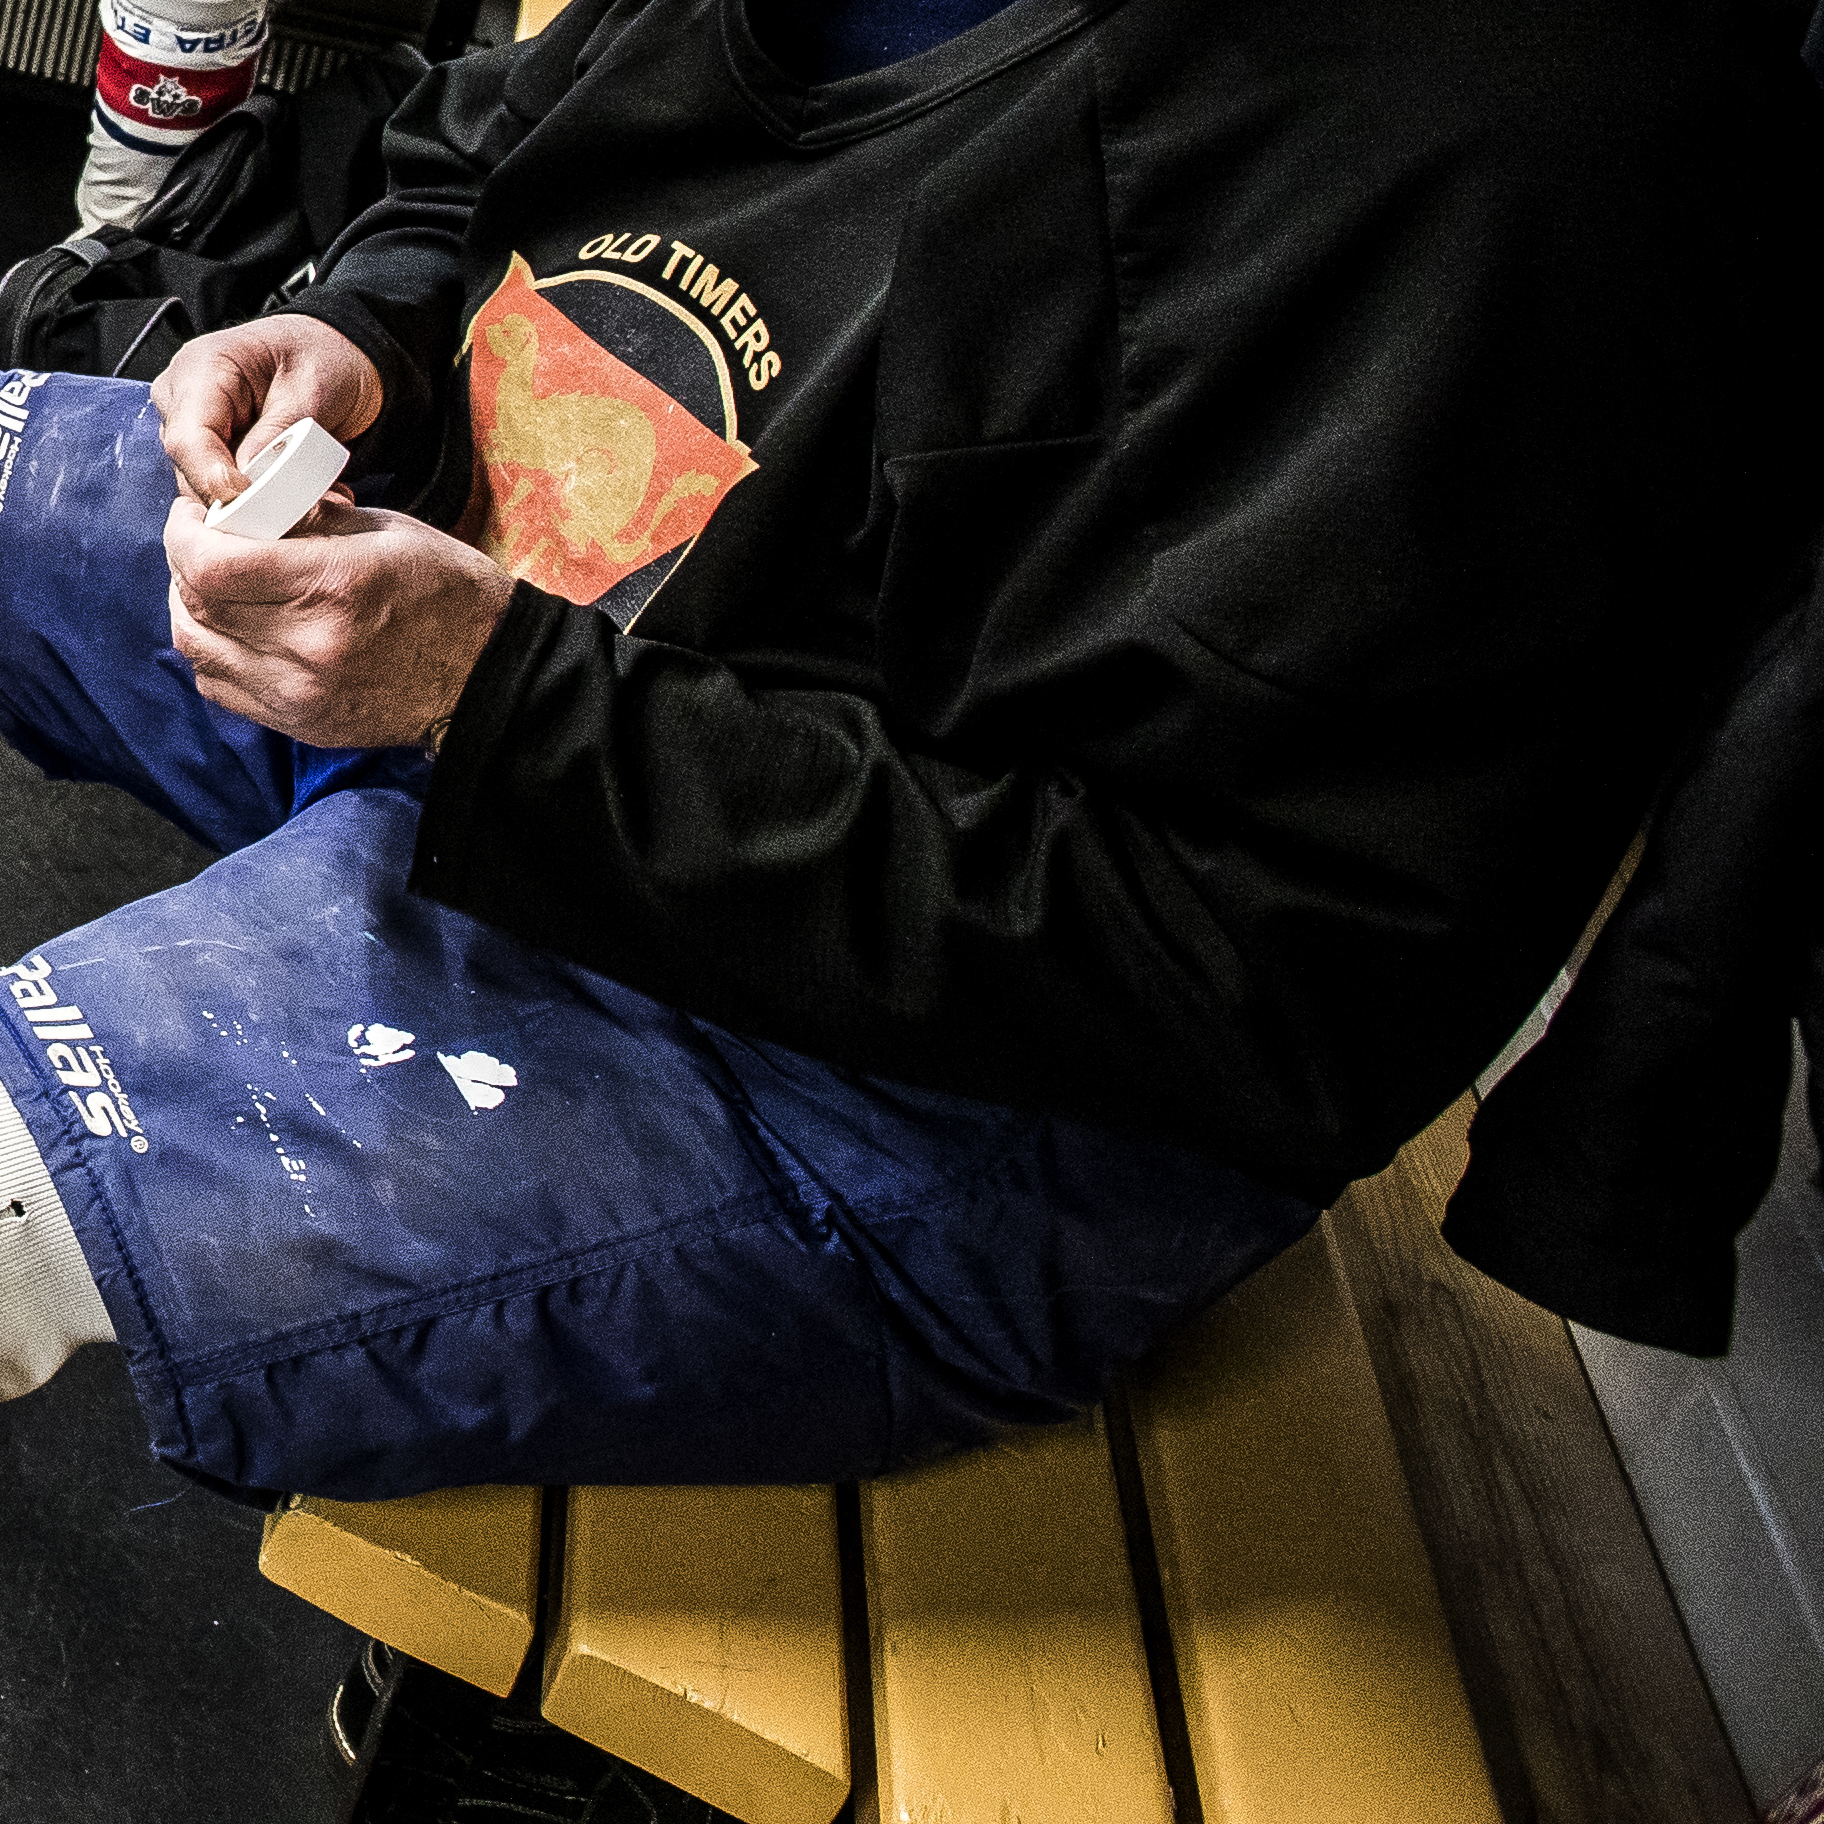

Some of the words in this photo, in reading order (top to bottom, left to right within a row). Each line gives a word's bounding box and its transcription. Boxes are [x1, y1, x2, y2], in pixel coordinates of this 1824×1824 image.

[578, 232, 661, 263] OLD
[661, 239, 782, 391] TIMERS
[88, 1045, 144, 1134] Hockey
